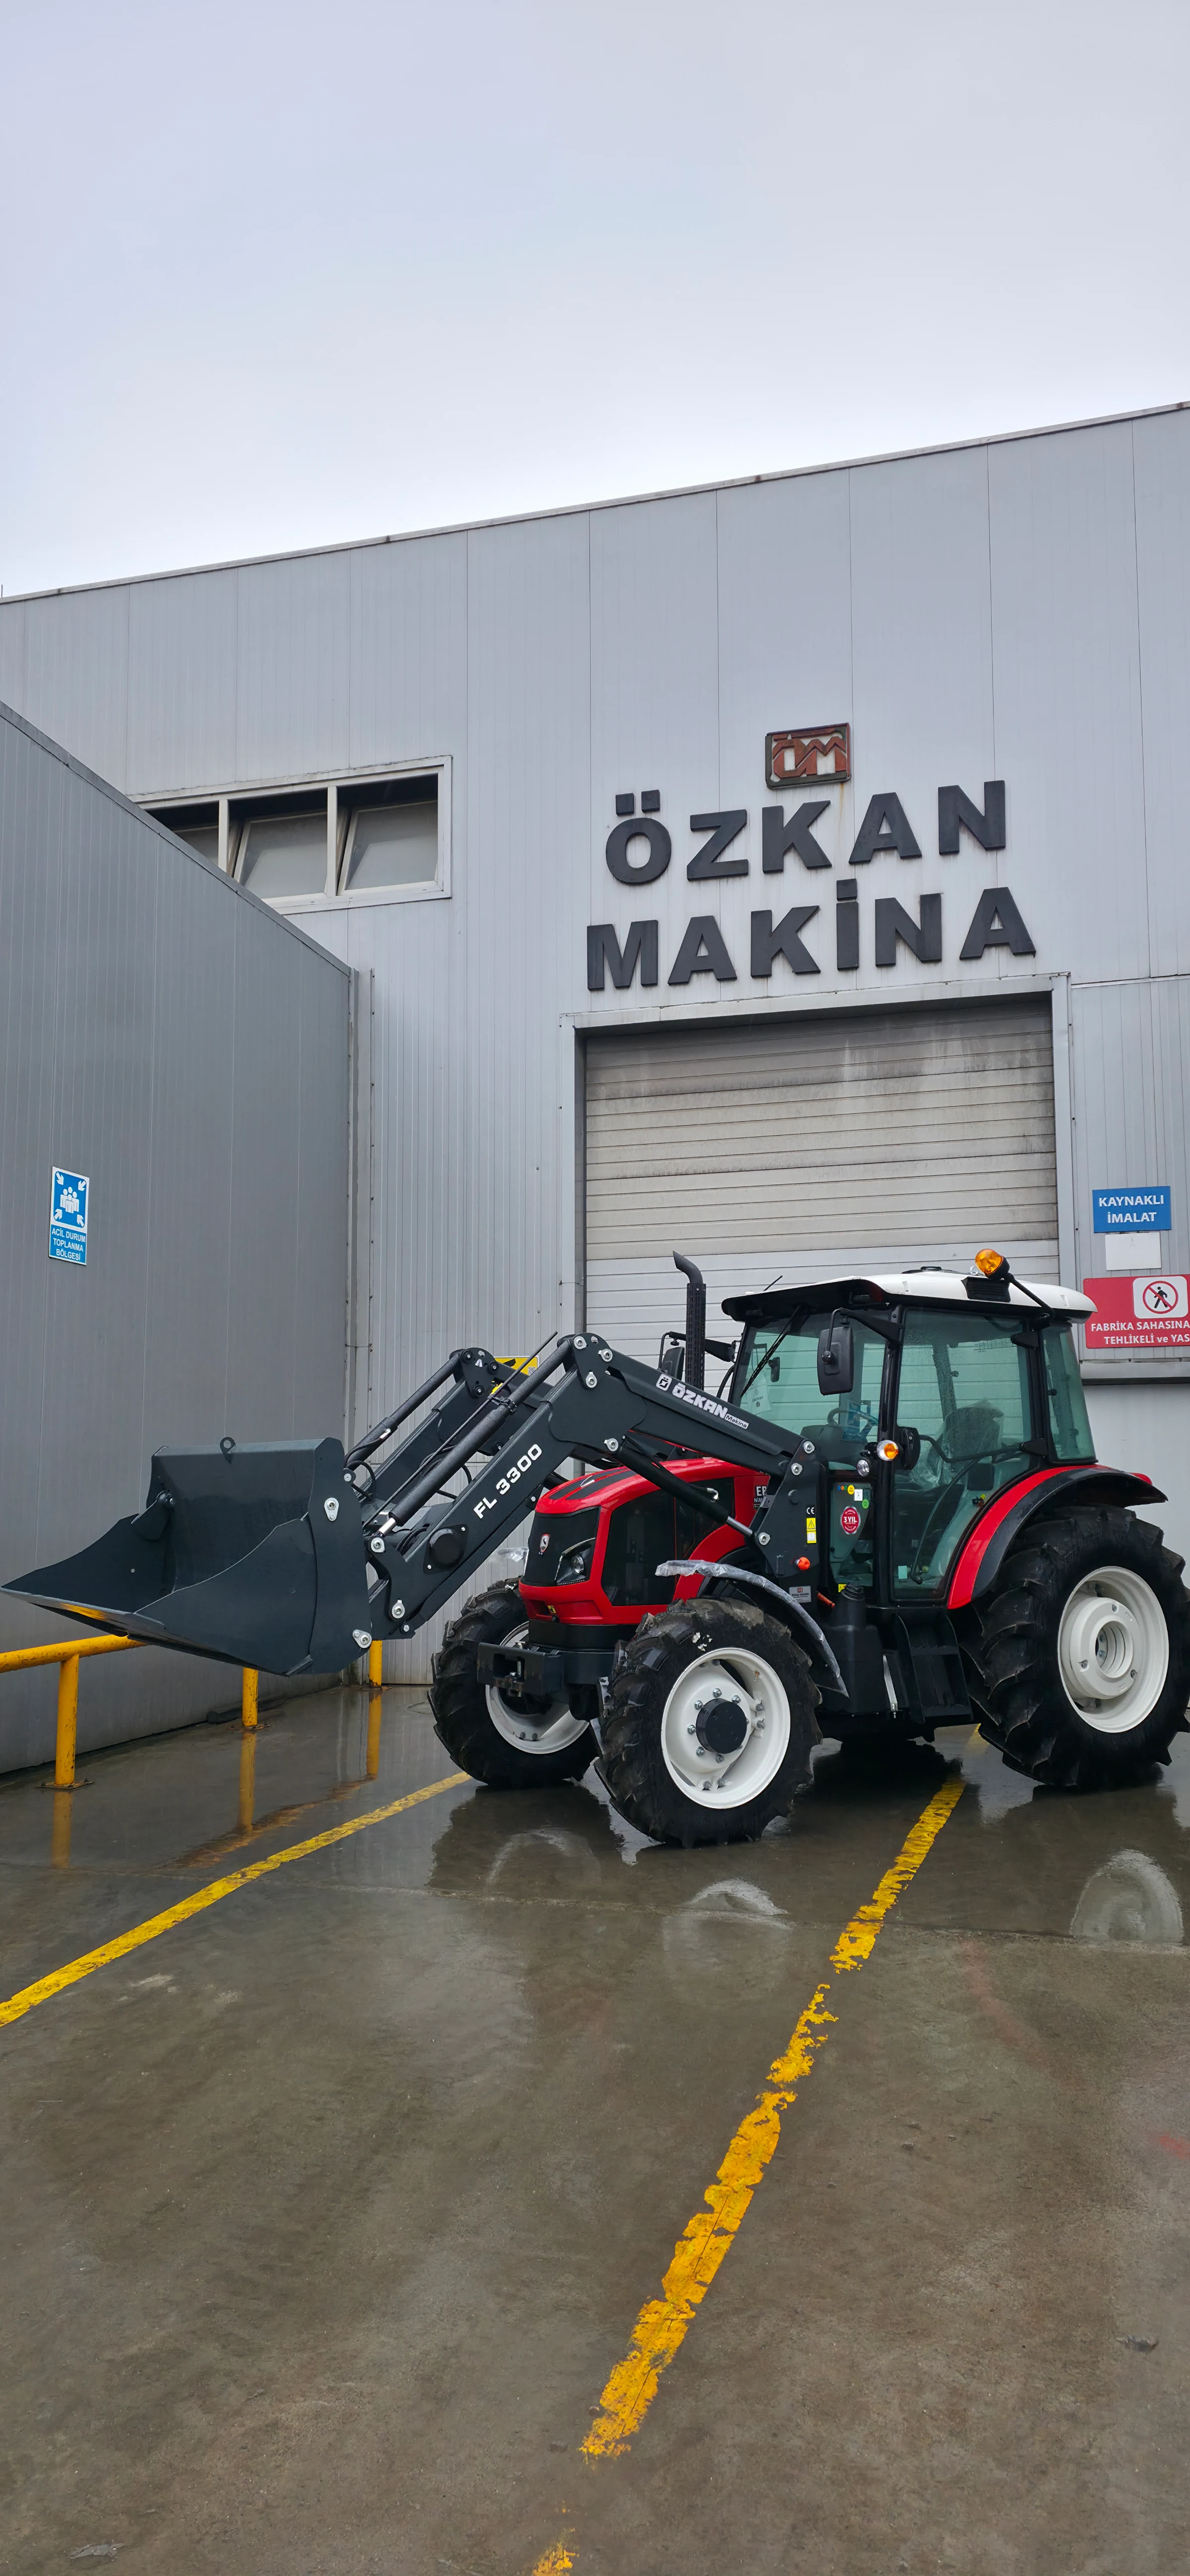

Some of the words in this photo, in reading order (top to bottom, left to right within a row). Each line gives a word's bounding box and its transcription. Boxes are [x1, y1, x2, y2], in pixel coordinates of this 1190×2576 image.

[605, 780, 1006, 885] ÖZKAN
[587, 878, 1036, 991] MAKİNA
[1099, 1195, 1164, 1207] KAYNAKLI
[1107, 1211, 1157, 1223] İMALAT
[52, 1228, 65, 1237] ACİL
[66, 1231, 86, 1243] DURUM
[53, 1238, 83, 1252] TOPLANMA
[56, 1249, 81, 1261] BÖLGESİ
[1091, 1321, 1134, 1331] FABRİKA
[1136, 1320, 1190, 1330] SAHASINA
[1104, 1333, 1154, 1345] TEHLİKELİ
[672, 1382, 728, 1419] ÖZKAN
[725, 1415, 748, 1429] Makina
[474, 1497, 497, 1519] FL
[496, 1444, 542, 1495] 3300
